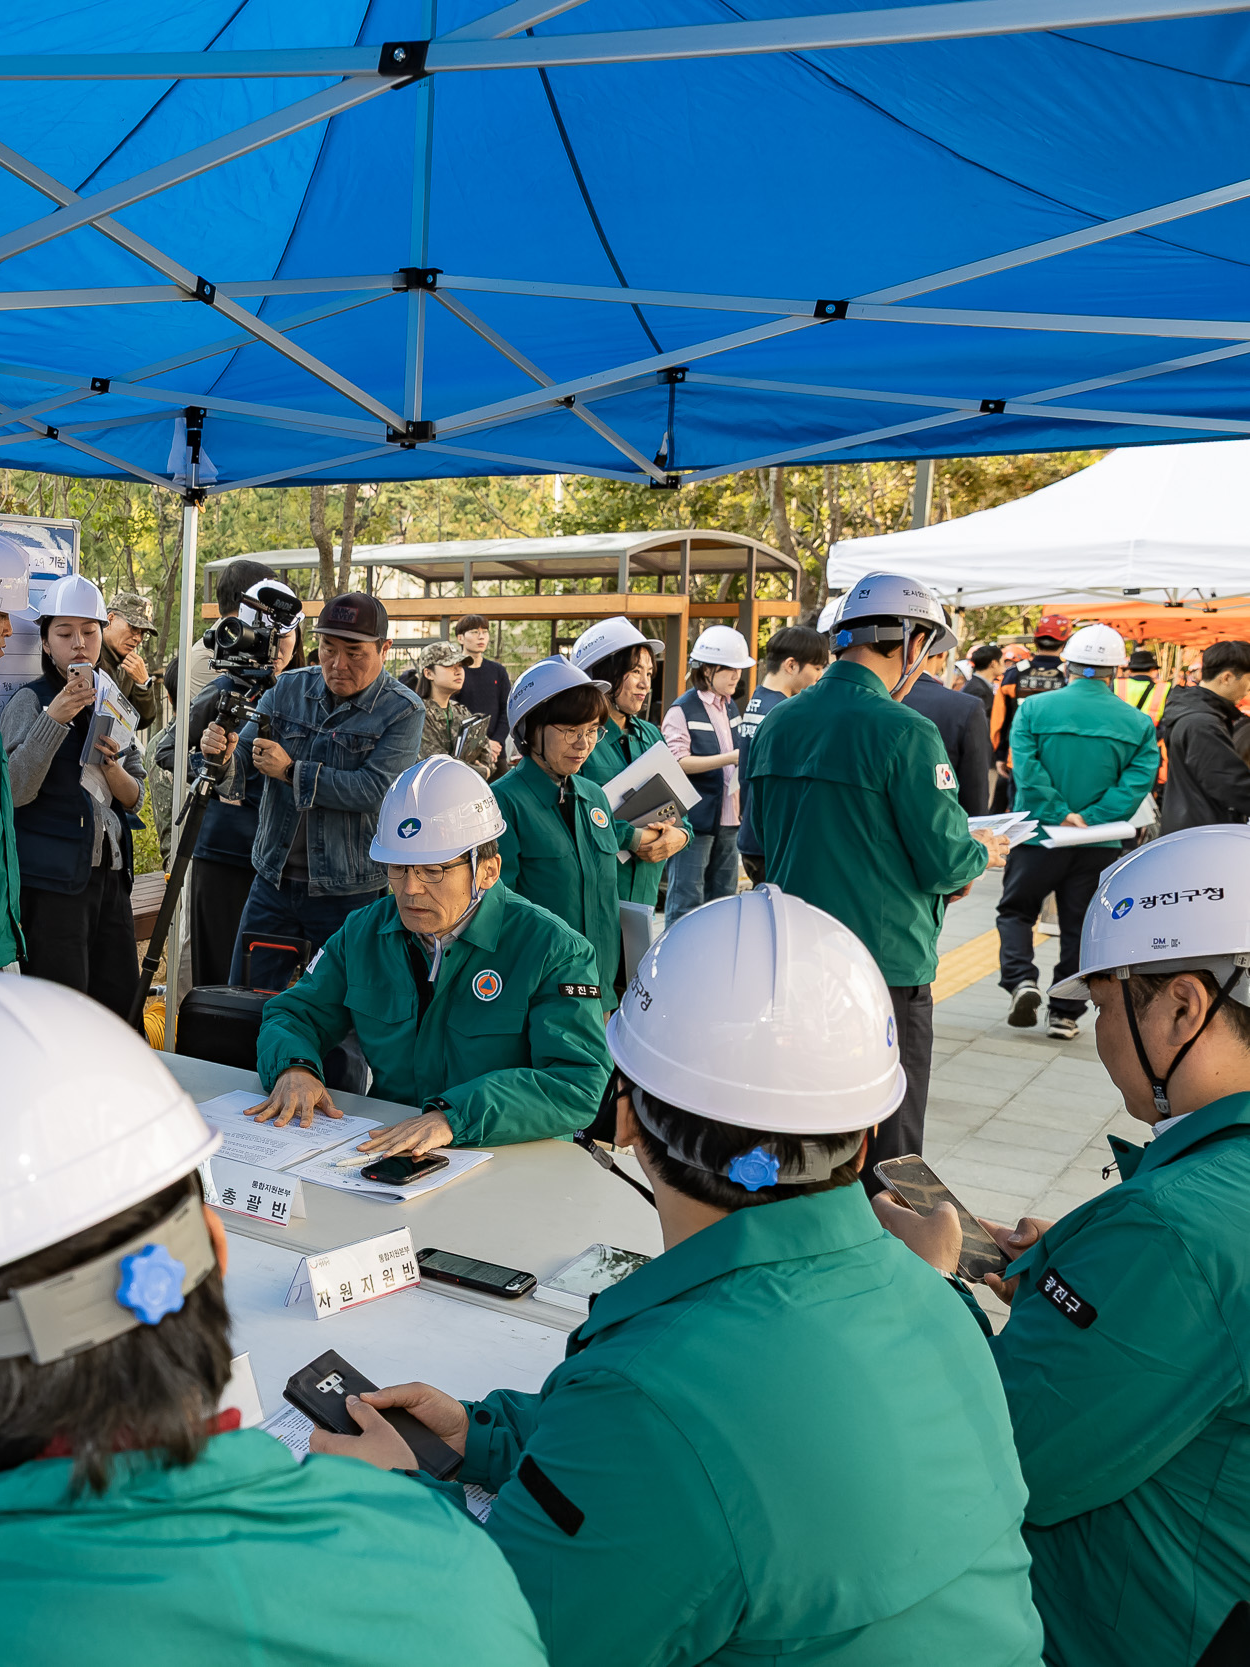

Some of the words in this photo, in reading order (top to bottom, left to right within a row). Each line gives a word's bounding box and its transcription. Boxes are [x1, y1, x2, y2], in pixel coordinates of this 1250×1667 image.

[49, 556, 66, 569] 기준
[1138, 886, 1226, 911] 광진구청
[251, 1179, 292, 1199] 통합지원본부
